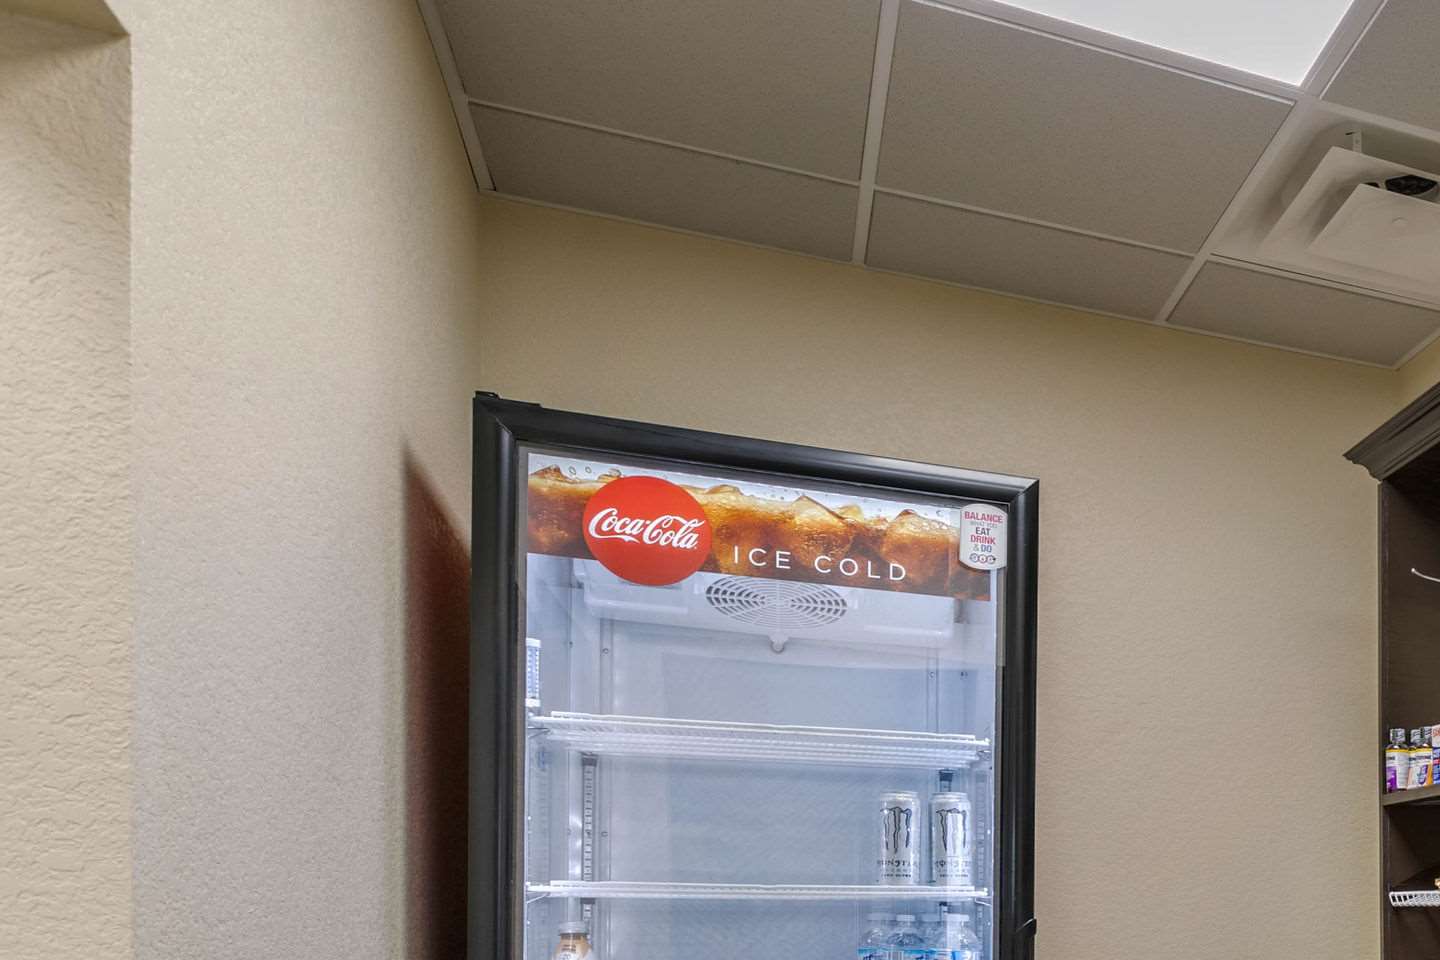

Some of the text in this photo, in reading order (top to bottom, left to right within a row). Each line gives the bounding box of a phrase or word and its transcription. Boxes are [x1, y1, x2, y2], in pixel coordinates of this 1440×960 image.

[964, 511, 1003, 524] BALANCE
[588, 507, 705, 550] Coca-Cola
[975, 526, 991, 536] EAT
[970, 534, 995, 545] DRINK
[980, 543, 992, 553] DO
[733, 545, 906, 581] ICE COLD
